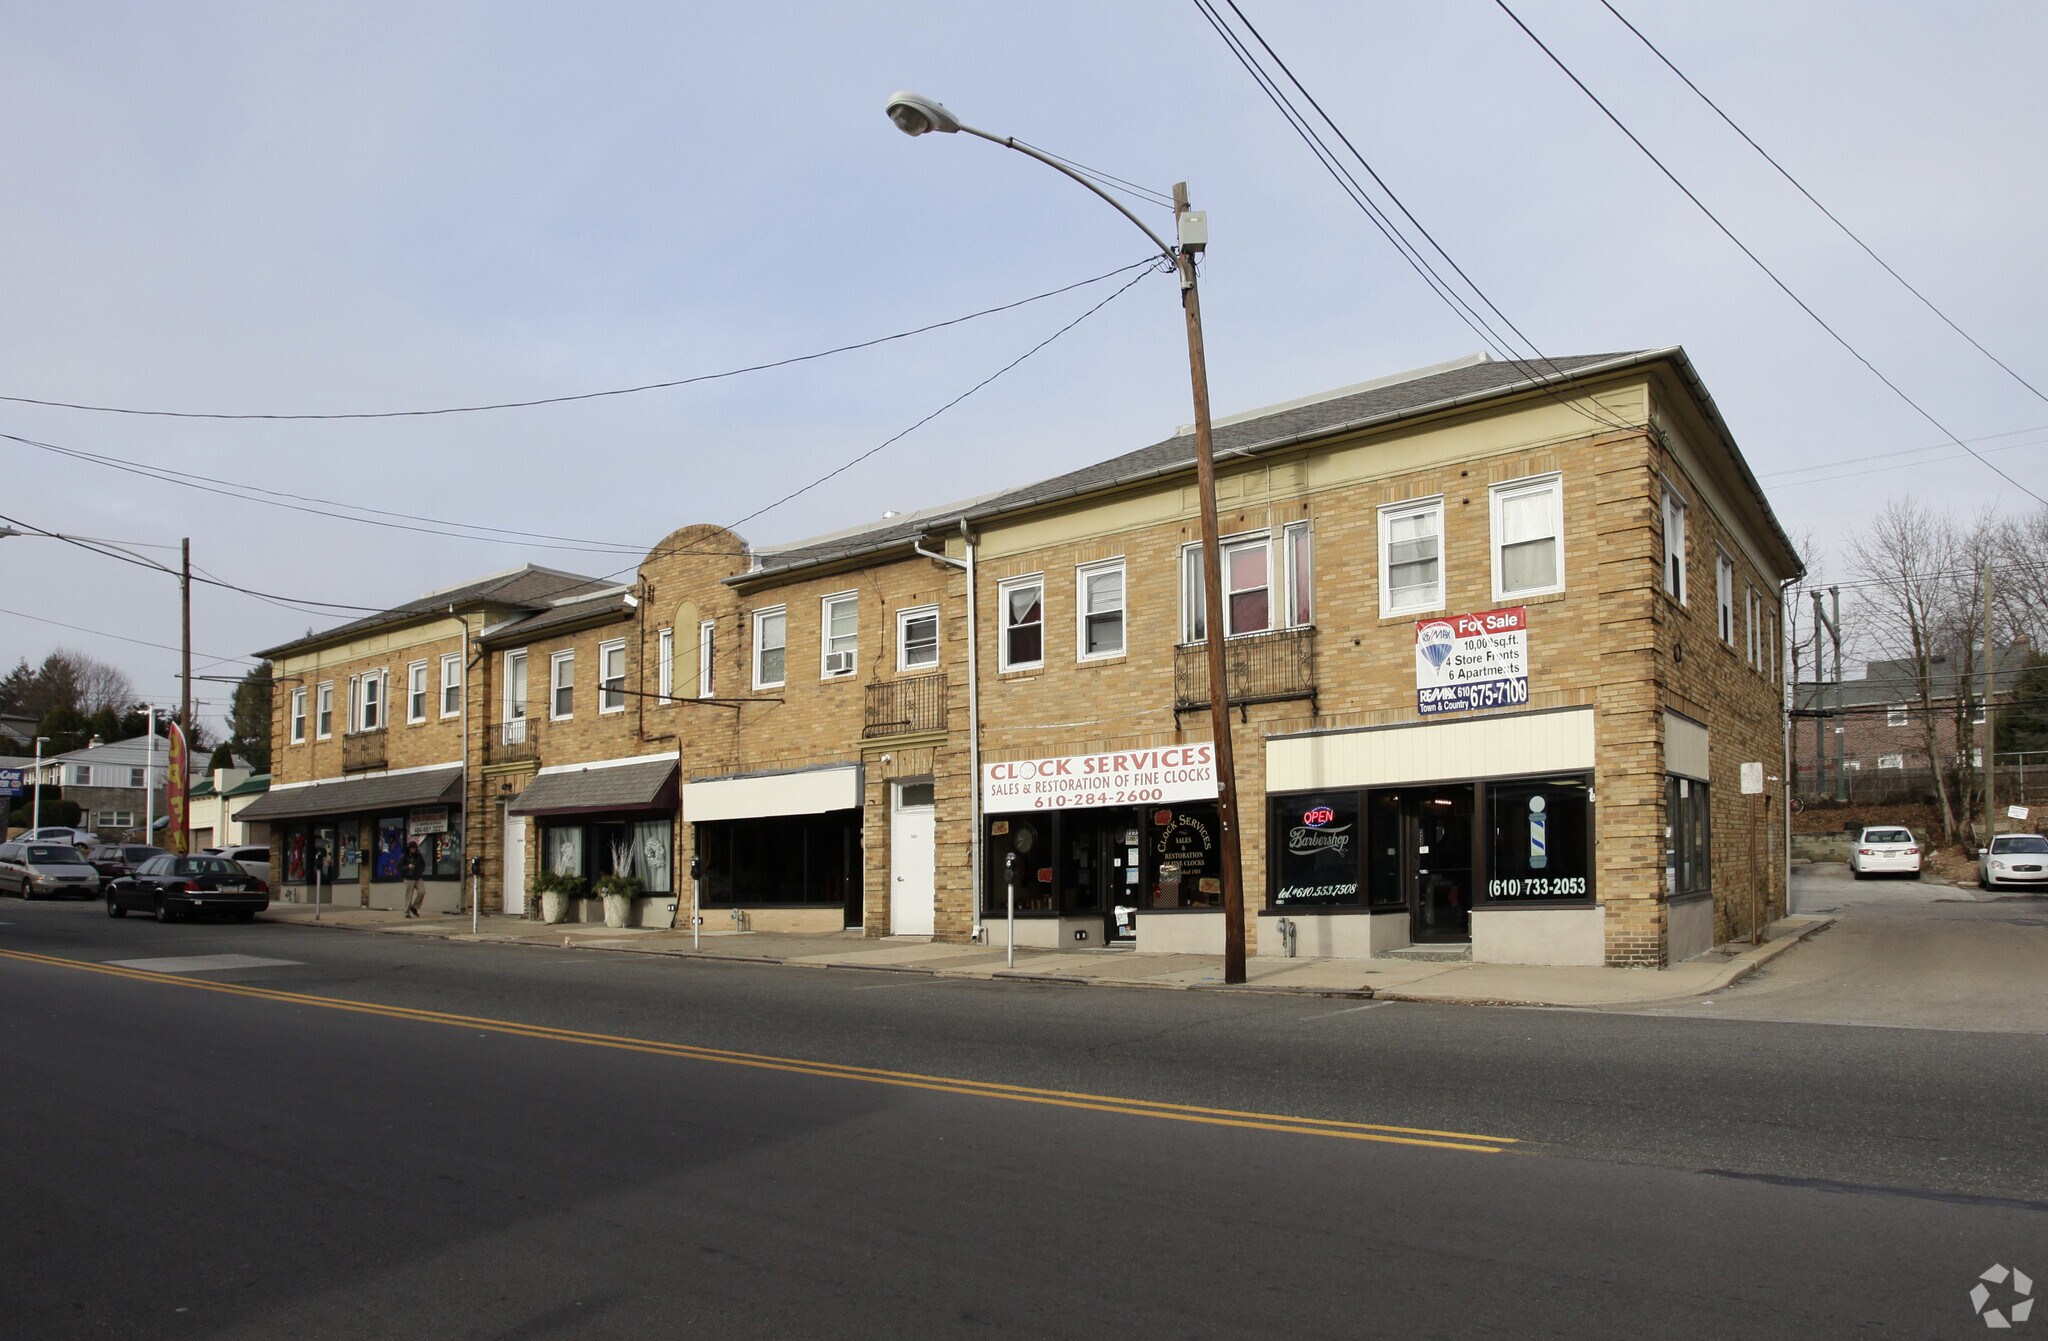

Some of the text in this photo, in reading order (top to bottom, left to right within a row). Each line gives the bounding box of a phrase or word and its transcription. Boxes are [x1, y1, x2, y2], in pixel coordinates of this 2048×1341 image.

[1459, 613, 1518, 633] For Sale
[1446, 649, 1520, 666] 4 Store Frnts
[1449, 663, 1520, 680] 6 Apartmets
[1457, 685, 1470, 697] 610
[1470, 679, 1527, 708] 675-7100
[1420, 699, 1469, 713] Town & Country
[990, 746, 1211, 781] CLOCK SERVICES
[0, 769, 20, 780] CARE
[991, 767, 1210, 797] SALES & RESTORATION OF FINE CLOCKS
[1034, 788, 1163, 808] 610-284-2600
[1303, 809, 1334, 824] OPEN
[1157, 819, 1178, 853] CLOCK
[1178, 814, 1212, 851] SERVICES
[1289, 828, 1349, 851] Barbershop
[1488, 876, 1586, 898] (610) 733-2053
